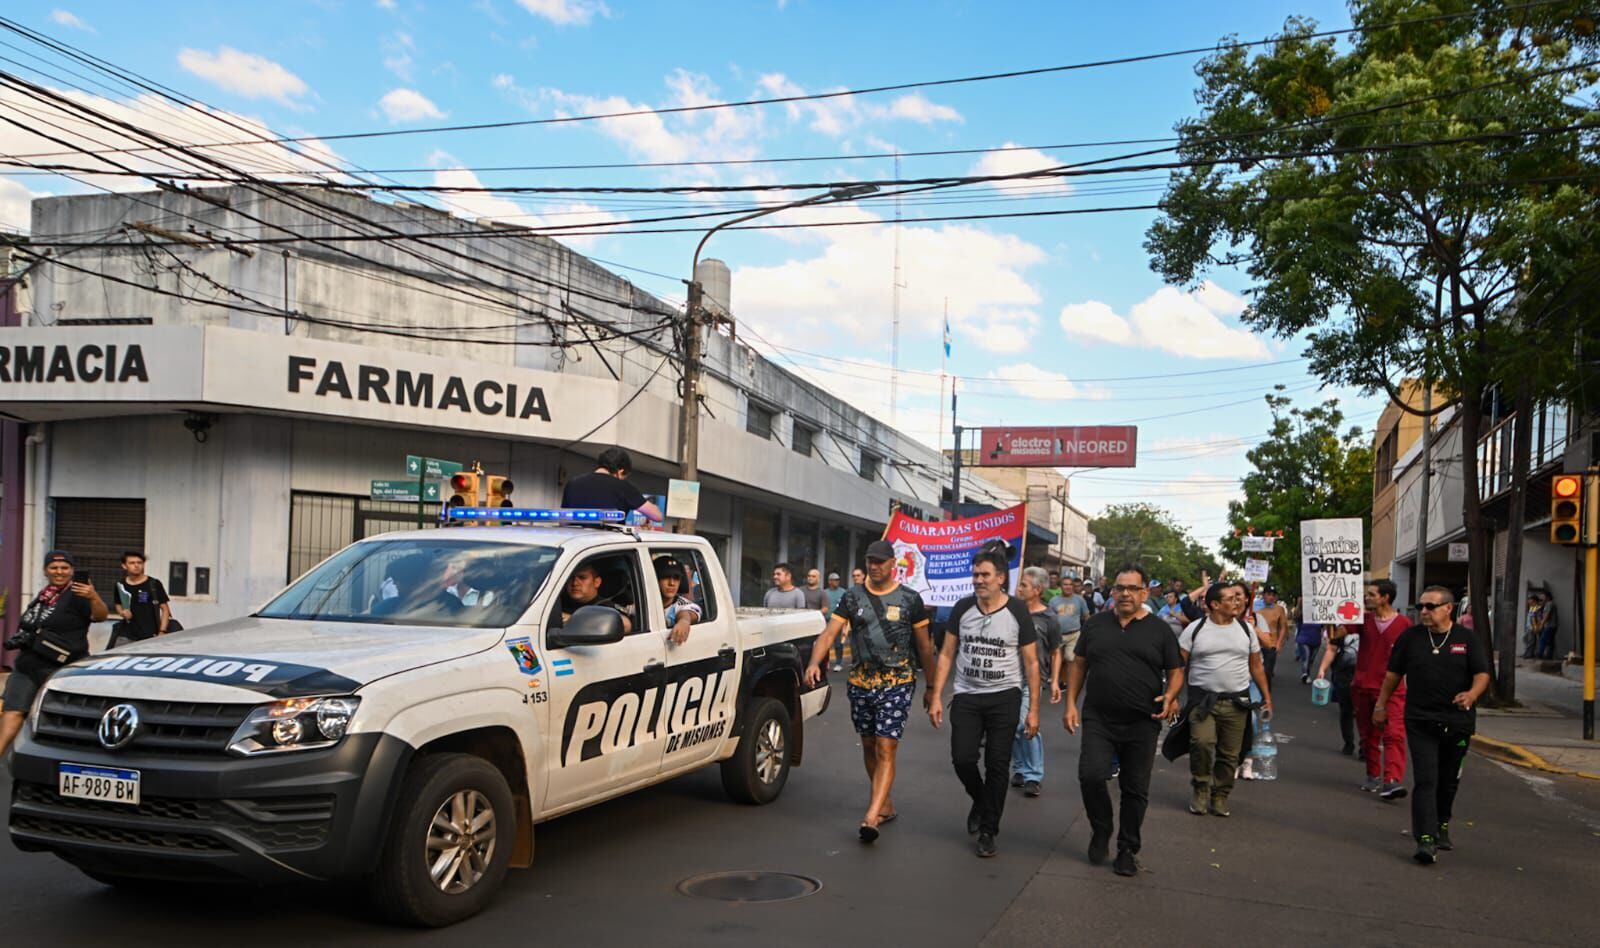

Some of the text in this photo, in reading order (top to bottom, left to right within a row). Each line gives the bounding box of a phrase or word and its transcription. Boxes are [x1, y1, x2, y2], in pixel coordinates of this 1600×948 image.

[287, 355, 552, 423] FARMACIA
[1010, 436, 1051, 448] electro
[1066, 440, 1128, 455] NEORED
[1010, 447, 1051, 456] misiones
[899, 512, 1015, 536] CAMARADAS UNIDOS
[930, 552, 971, 560] PERSONAL
[929, 559, 969, 567] RETIRADO
[1312, 599, 1334, 607] SALUD
[1318, 606, 1328, 614] EN
[1312, 612, 1336, 622] LUCHA
[971, 646, 1007, 658] MISIONES
[970, 657, 993, 668] NO ES
[963, 667, 980, 678] PARA
[530, 691, 547, 704] 153
[563, 669, 731, 767] POLICIA
[666, 720, 727, 754] DE MISIONES
[63, 775, 135, 800] AF 989 BW
